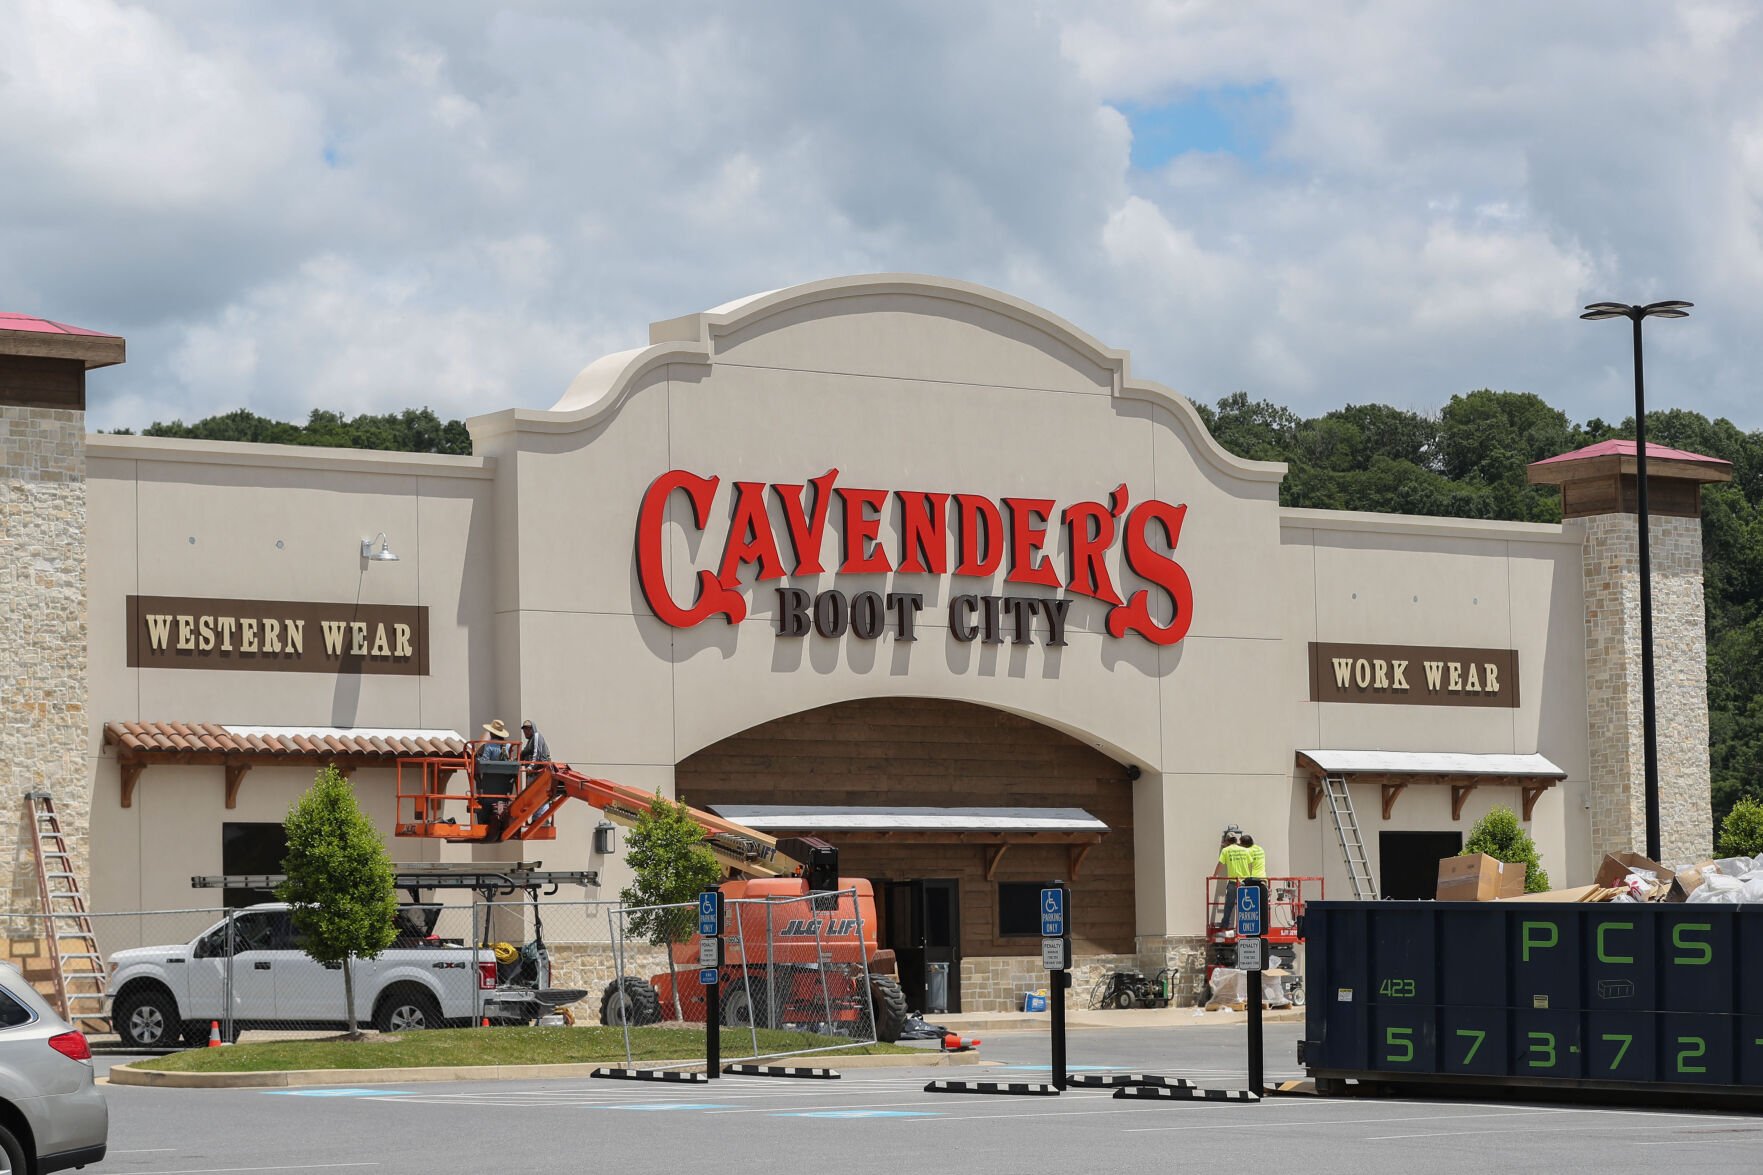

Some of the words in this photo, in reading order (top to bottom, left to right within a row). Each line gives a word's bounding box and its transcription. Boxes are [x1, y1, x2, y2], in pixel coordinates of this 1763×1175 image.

[635, 468, 1193, 646] CAVENDER'S
[775, 588, 923, 642] BOOT
[949, 594, 1074, 646] CITY
[146, 614, 305, 653] WESTERN
[321, 621, 413, 657] WEAR
[1332, 658, 1410, 689] WORK
[1424, 661, 1500, 692] WEAR
[1042, 913, 1062, 922] PARKING
[1239, 911, 1259, 921] PARKING
[780, 919, 822, 936] JLG
[1046, 923, 1058, 933] ONLY
[1242, 923, 1255, 932] ONLY
[1379, 979, 1416, 997] 423
